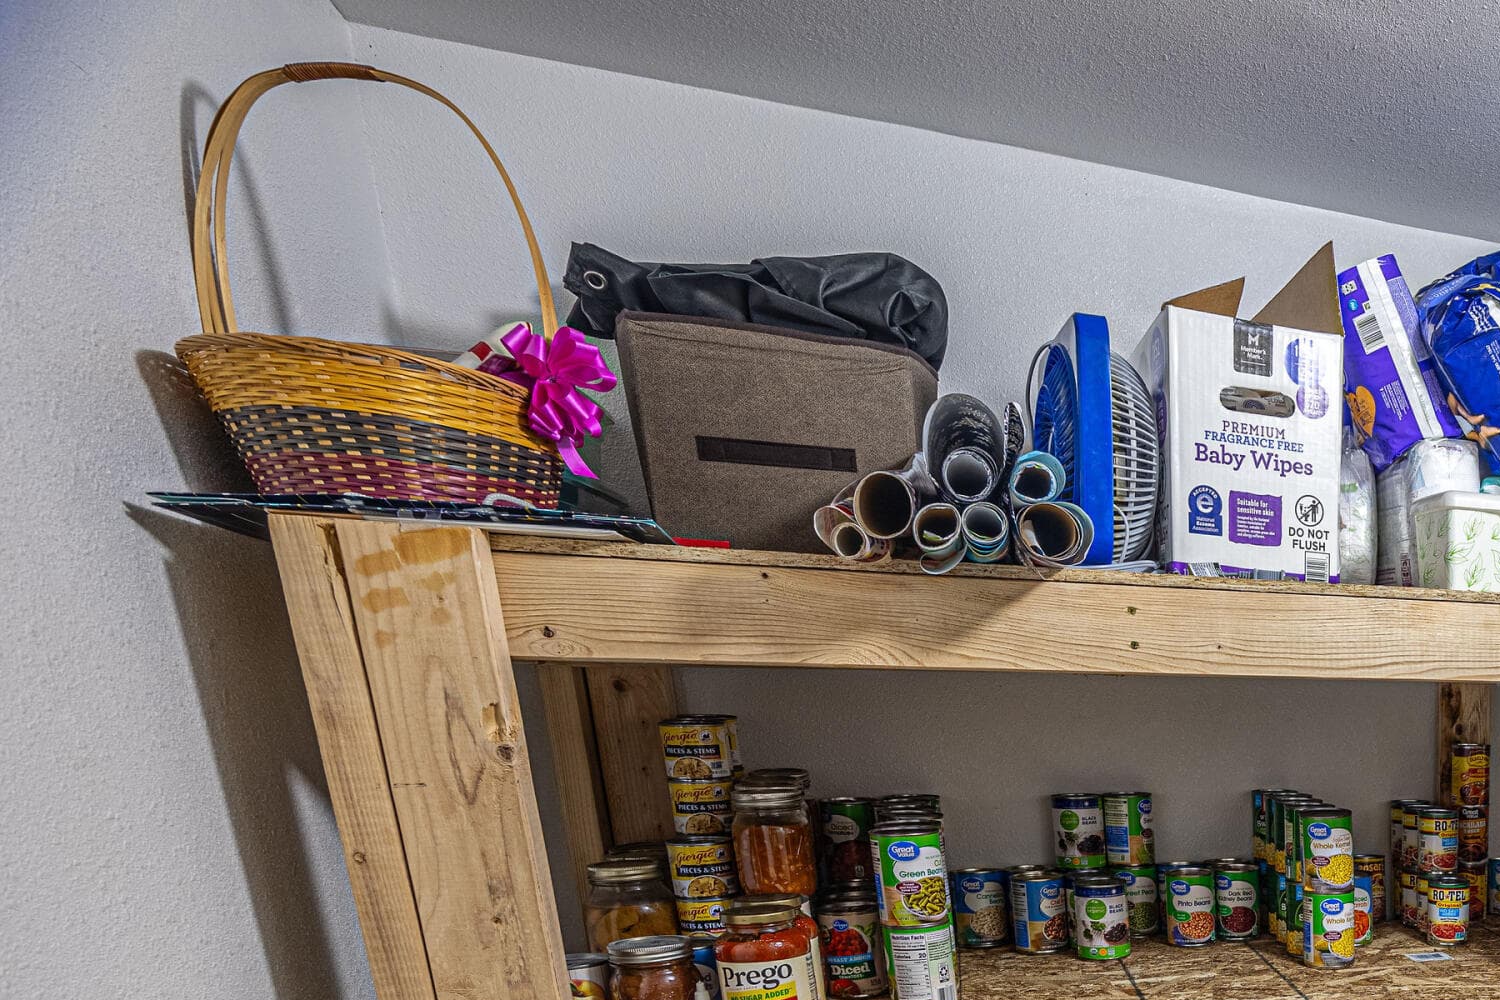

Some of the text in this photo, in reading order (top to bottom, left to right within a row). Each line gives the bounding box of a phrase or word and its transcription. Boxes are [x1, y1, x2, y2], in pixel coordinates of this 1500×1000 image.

[1222, 420, 1286, 440] PREMIUM
[1204, 430, 1304, 453] FRAGRANCE FREE
[1194, 442, 1314, 477] Baby Wipes
[1192, 487, 1218, 499] ACCEPTED
[1236, 498, 1258, 507] Suitable
[1236, 507, 1275, 517] sensitive skin
[1288, 527, 1330, 540] DO NOT
[1292, 539, 1326, 552] FLUSH
[891, 846, 915, 854] Great
[899, 870, 926, 879] Green
[1177, 899, 1211, 907] Pinto Beans
[830, 962, 871, 976] Diced
[722, 963, 793, 990] Prego
[764, 988, 790, 1000] ADDED
